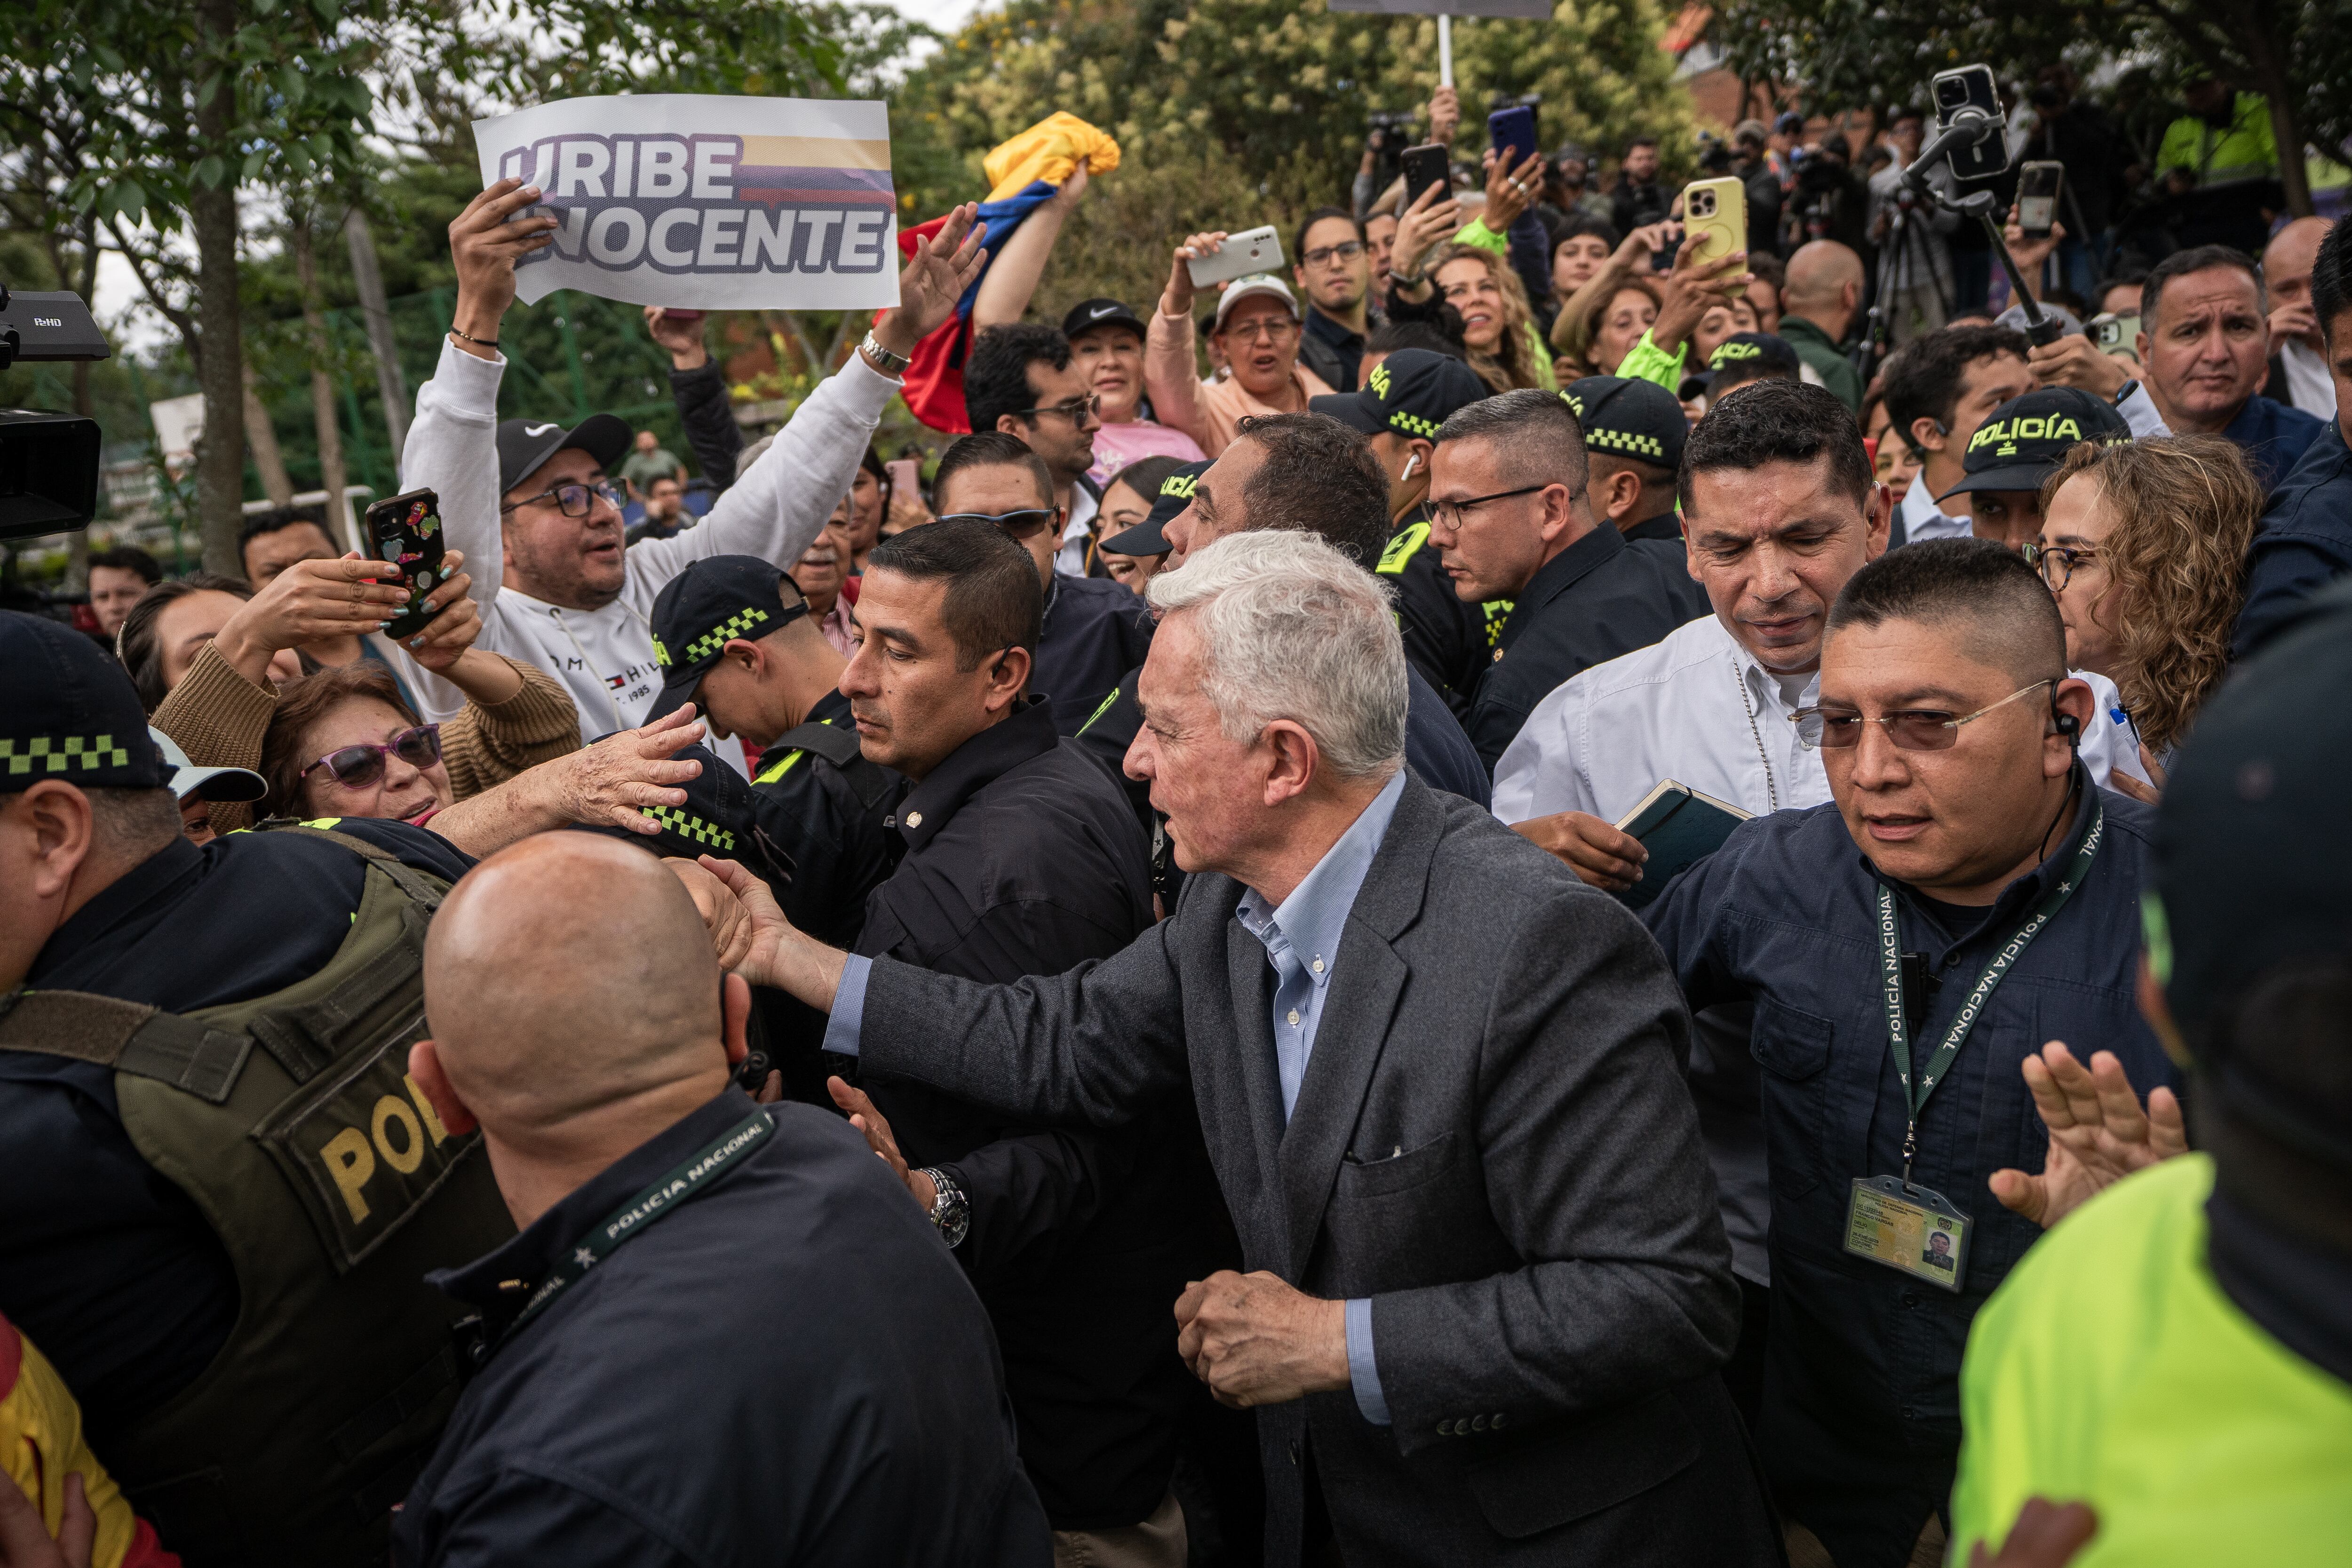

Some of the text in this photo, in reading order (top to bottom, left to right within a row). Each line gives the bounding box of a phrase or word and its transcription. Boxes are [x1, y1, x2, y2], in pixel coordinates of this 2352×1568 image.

[500, 135, 743, 199] URIBE
[34, 318, 62, 326] P2HD
[1967, 412, 2082, 454] POLICÍA
[628, 685, 650, 702] 1985
[1881, 891, 1902, 1042] POLICÍA NACIONAL
[1943, 914, 2046, 1050] POLICÍA NACIONAL
[687, 1122, 764, 1182] NACIONAL
[1855, 1210, 1874, 1220] FRANCO
[1875, 1217, 1893, 1227] VARGAS
[1851, 1238, 1873, 1249] CORONEL
